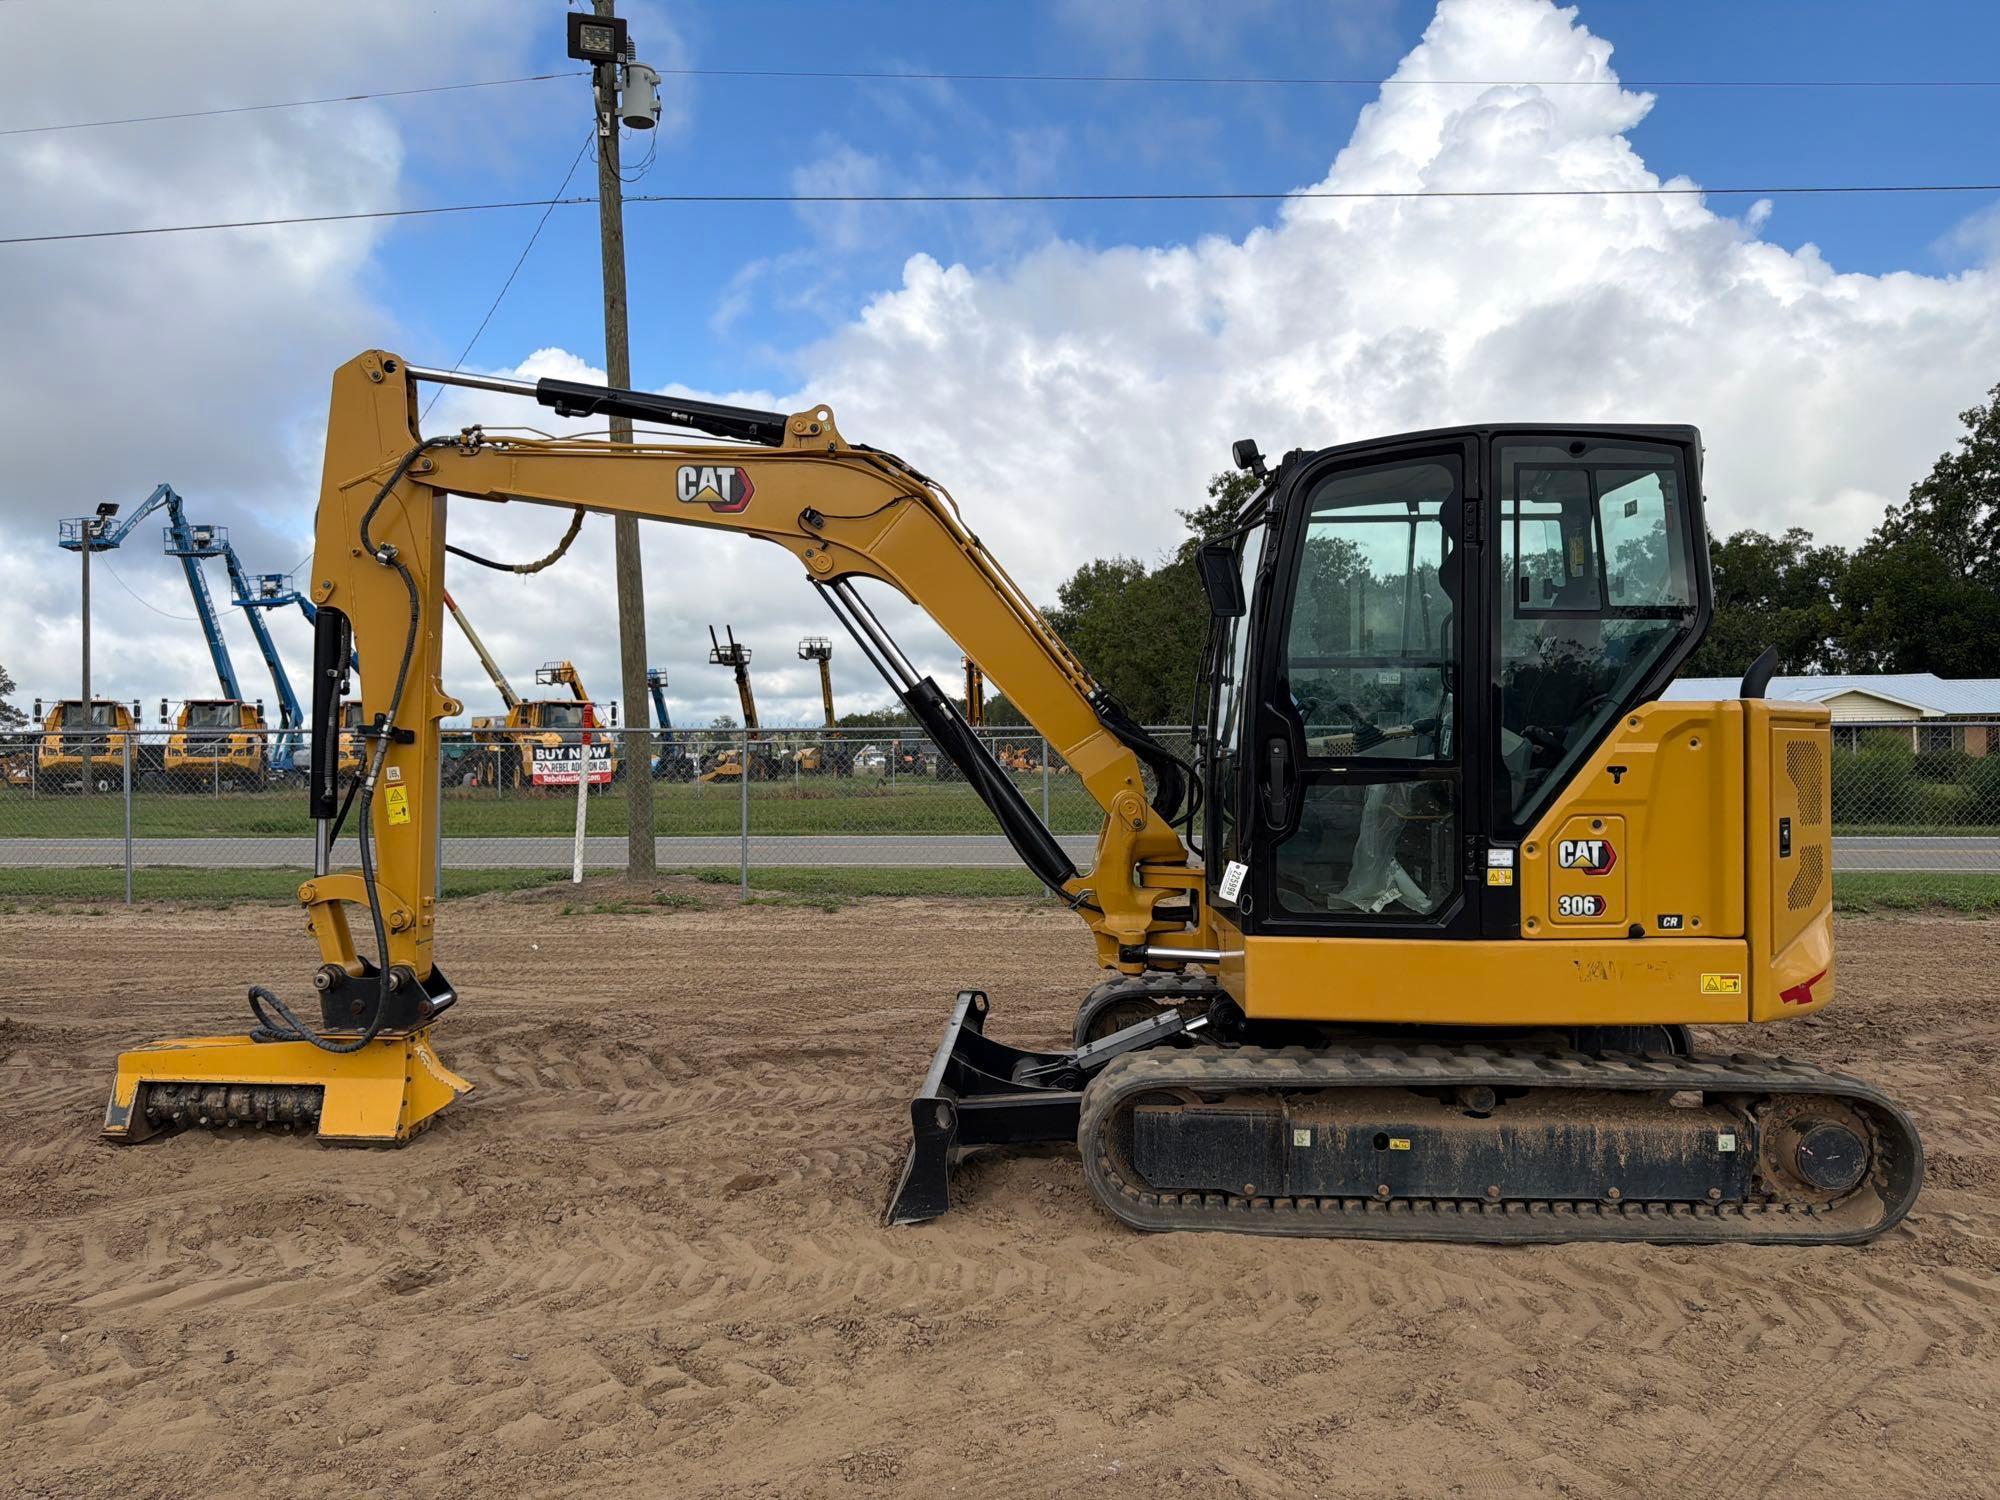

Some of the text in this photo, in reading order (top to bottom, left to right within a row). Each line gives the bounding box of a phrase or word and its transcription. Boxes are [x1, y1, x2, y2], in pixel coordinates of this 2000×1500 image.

[677, 466, 736, 502] CAT
[536, 746, 607, 760] BUY NW
[551, 762, 570, 773] REBEL
[1559, 840, 1603, 868] CAT
[1226, 870, 1242, 896] 225996
[1559, 896, 1596, 916] 306
[1662, 917, 1679, 927] CR
